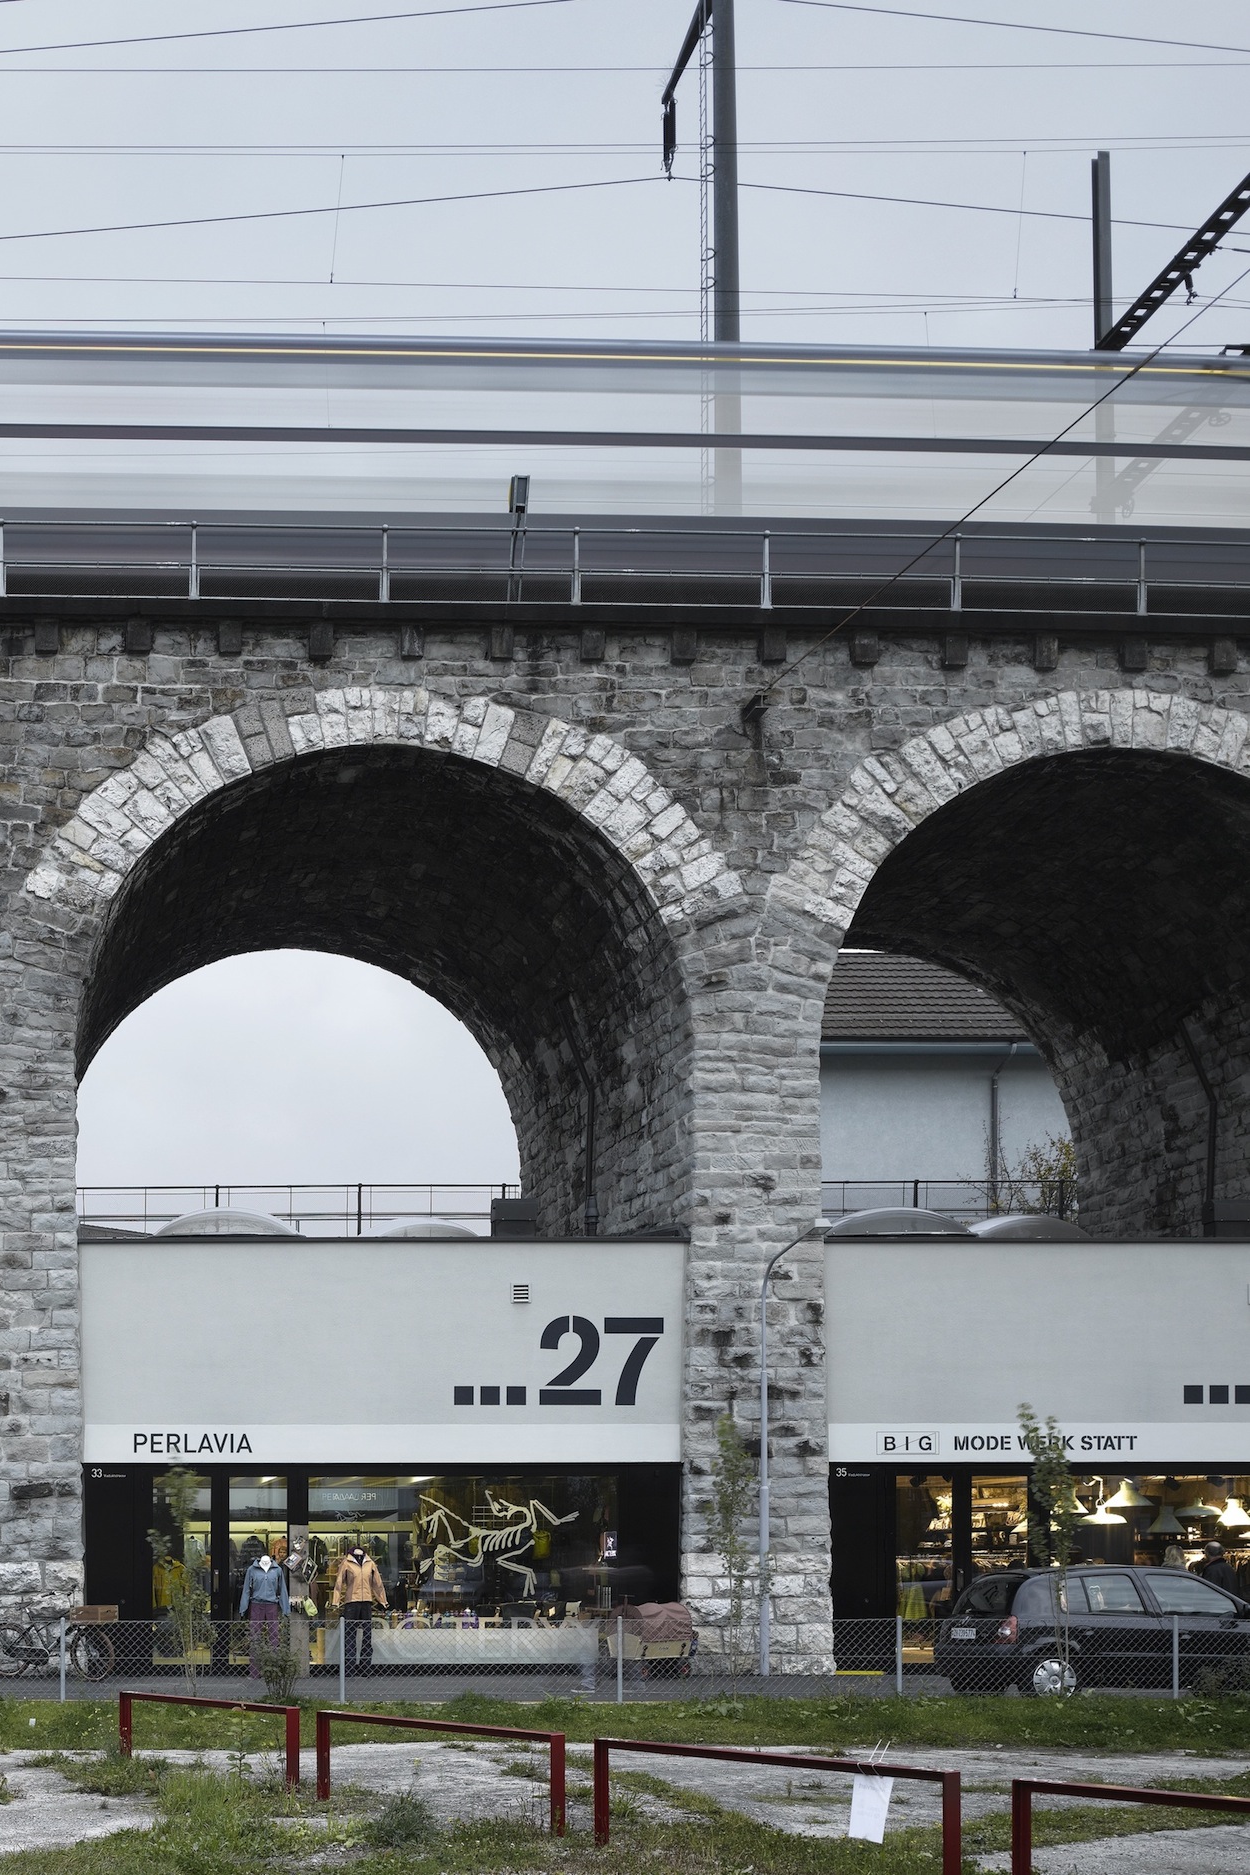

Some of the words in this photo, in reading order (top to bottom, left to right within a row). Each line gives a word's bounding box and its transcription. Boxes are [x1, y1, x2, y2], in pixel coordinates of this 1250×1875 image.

[133, 1433, 253, 1454] PERLAVIA
[954, 1435, 1012, 1451] MODE
[1080, 1435, 1138, 1451] STATT
[91, 1468, 103, 1479] 33
[835, 1467, 848, 1478] 35
